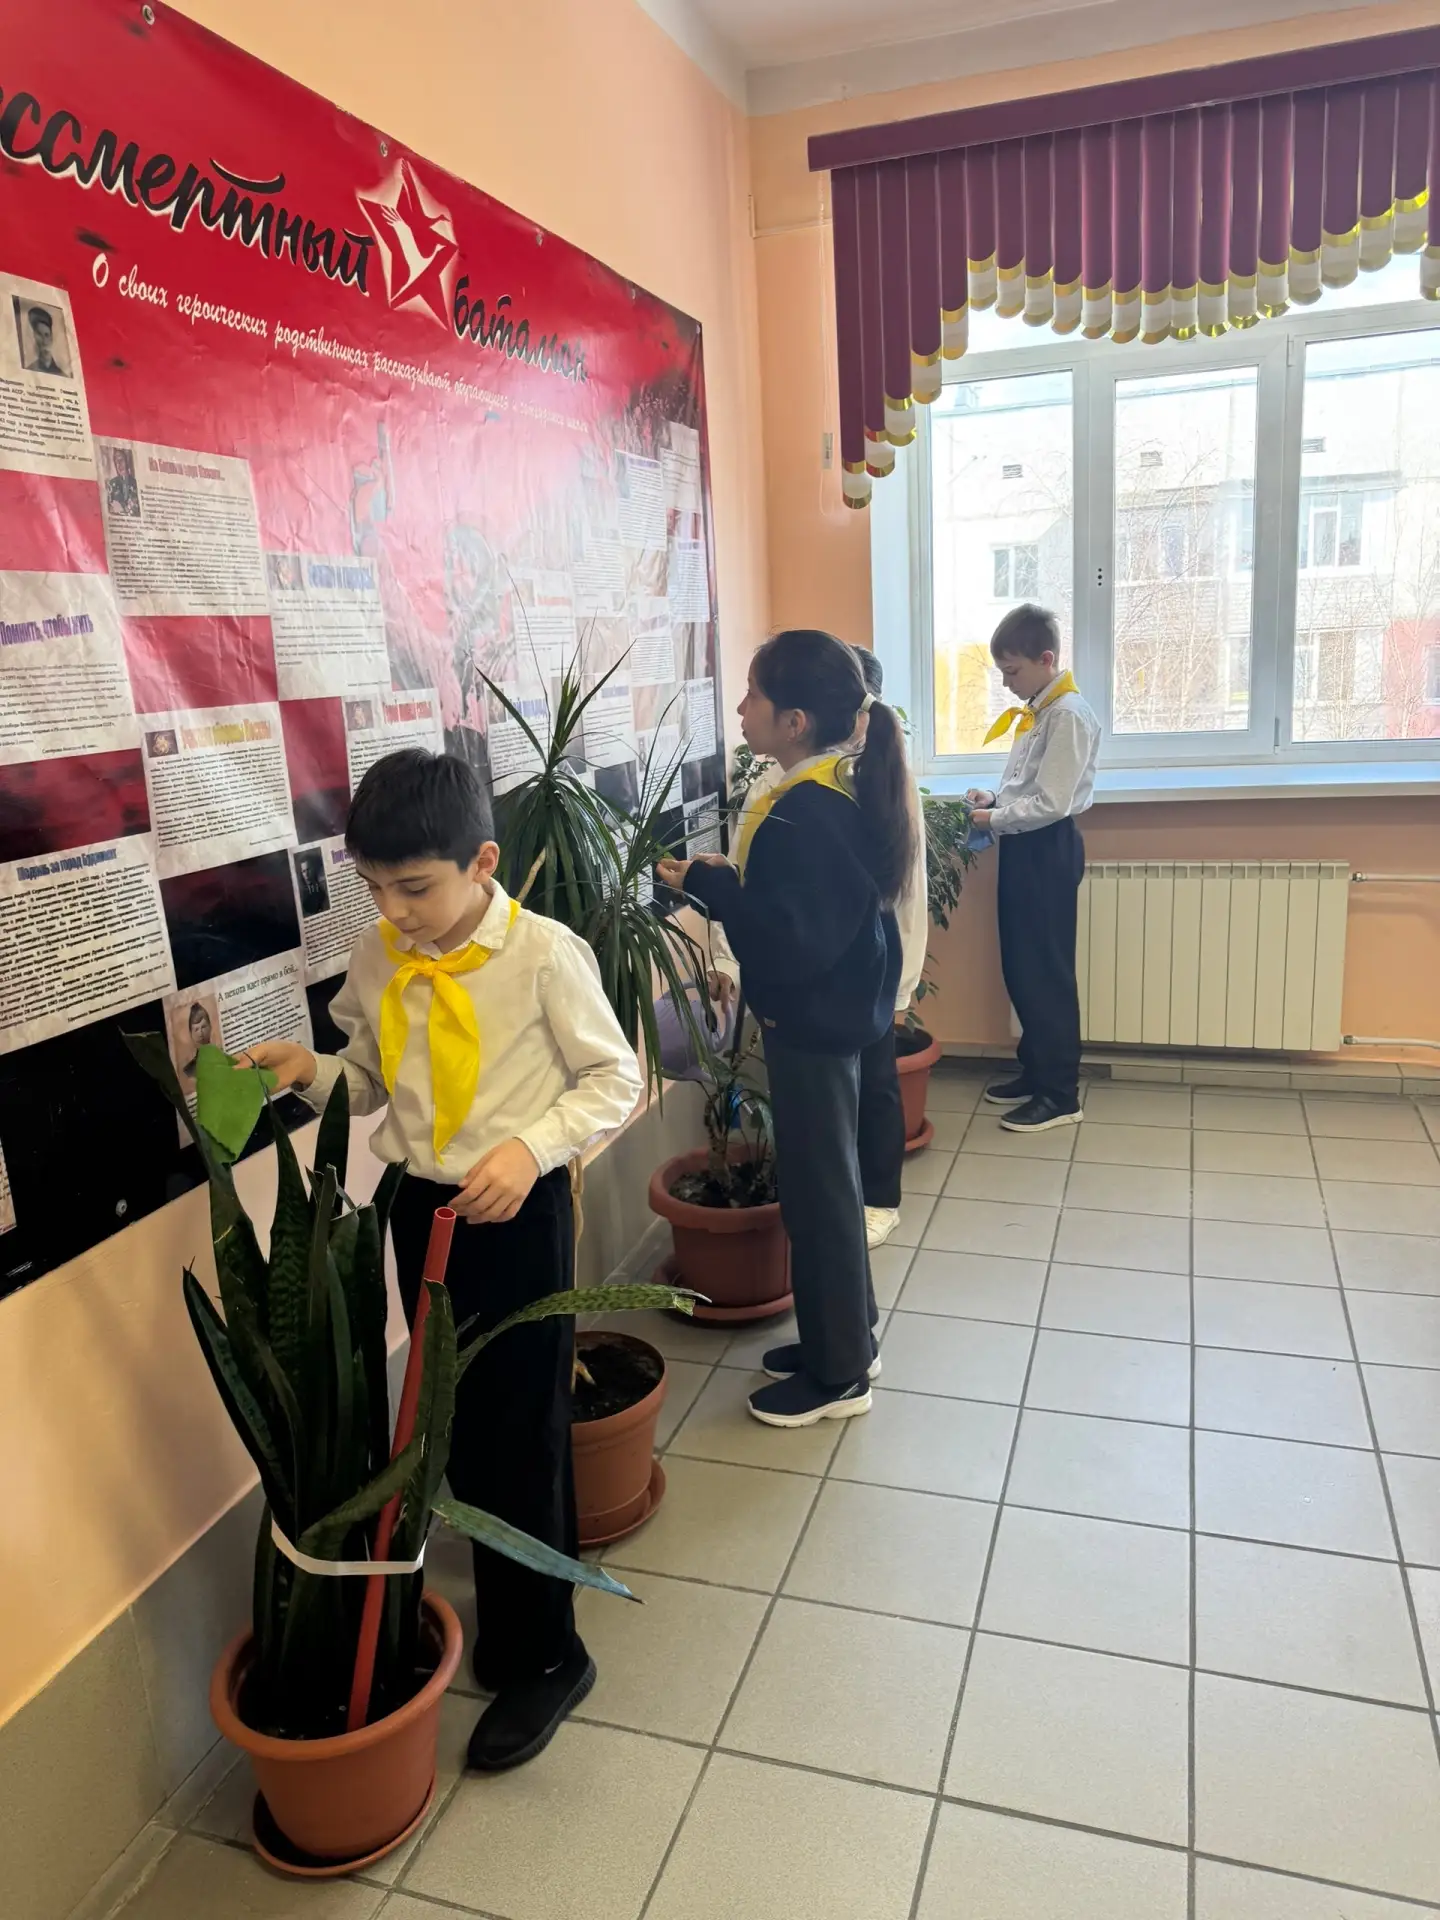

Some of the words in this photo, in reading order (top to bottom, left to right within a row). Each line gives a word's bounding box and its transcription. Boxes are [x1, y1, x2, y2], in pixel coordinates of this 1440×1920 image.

[0, 86, 373, 297] ссмертный
[454, 274, 588, 385] батальон
[92, 253, 109, 288] О
[119, 264, 169, 308] своих
[176, 293, 268, 338] героических
[371, 350, 452, 391] рассказывают
[0, 621, 43, 646] Помнить,
[42, 614, 72, 639] чтобы
[72, 614, 94, 635] жить
[217, 991, 224, 1003] А
